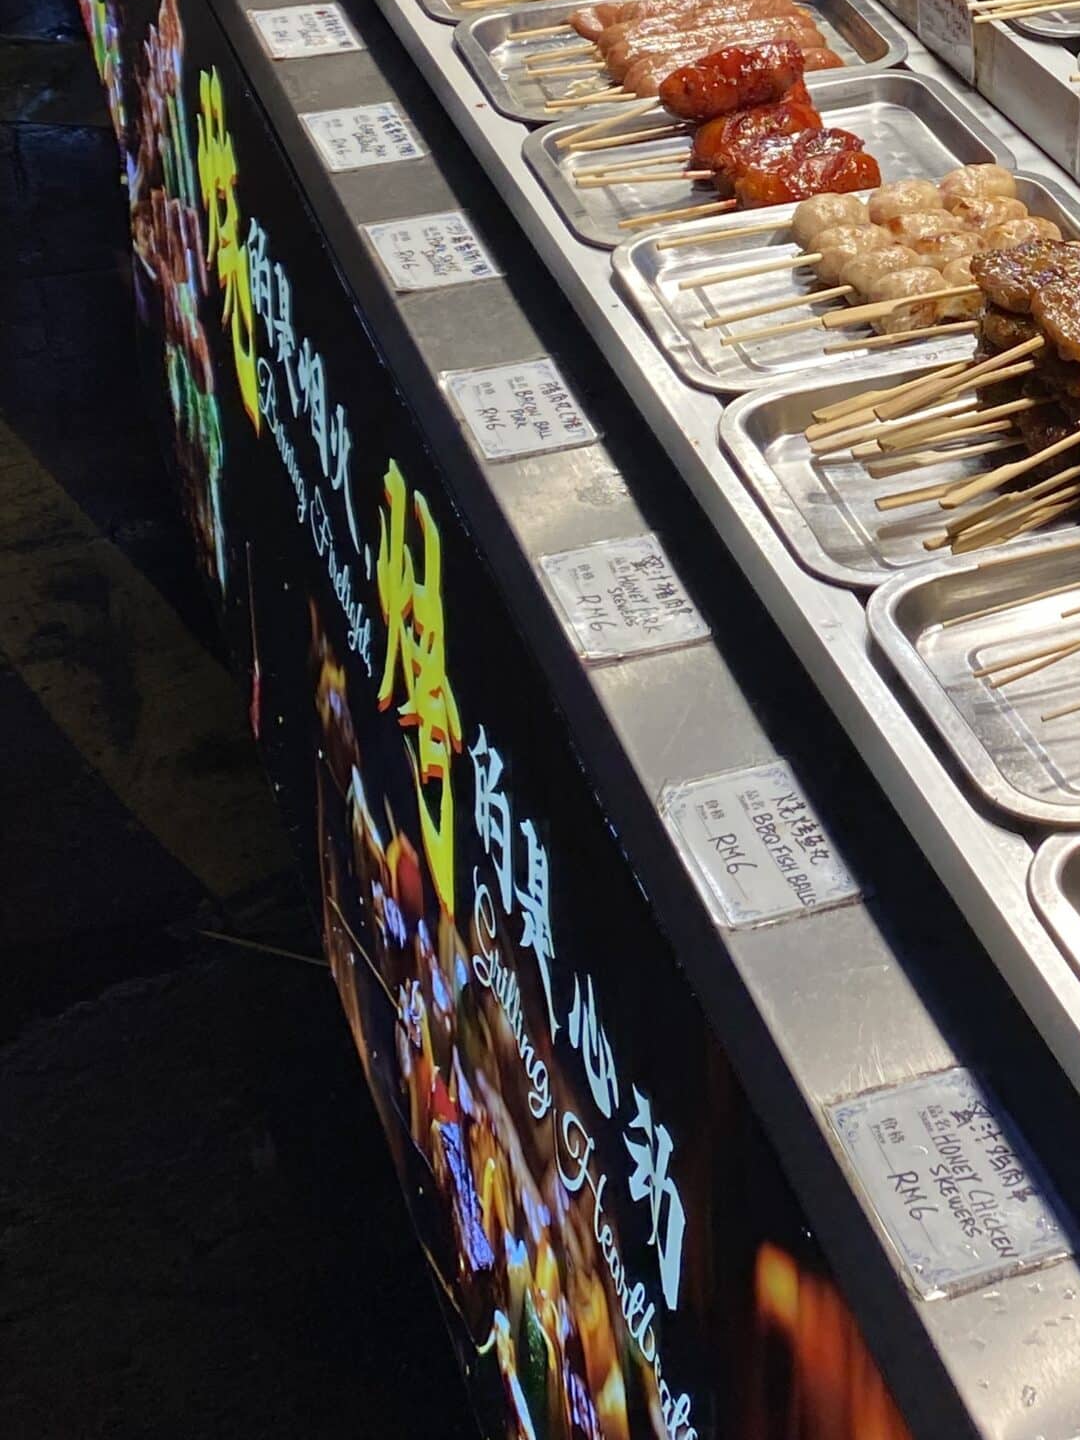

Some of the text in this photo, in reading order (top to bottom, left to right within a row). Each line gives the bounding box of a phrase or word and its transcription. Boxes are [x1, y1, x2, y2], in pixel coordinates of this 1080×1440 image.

[399, 250, 418, 269] RM6
[479, 408, 505, 430] RM6
[533, 421, 549, 439] BALL
[619, 576, 649, 602] HONEY
[578, 595, 616, 631] RM6
[256, 358, 307, 523] Burning
[471, 864, 552, 1120] Grilling
[770, 792, 830, 865] 烧烤鱼丸
[708, 834, 757, 874] RM6
[753, 813, 815, 904] BBQ FISH BALLS
[932, 1135, 981, 1181] HONEY
[888, 1171, 938, 1220] RM6
[930, 1164, 981, 1237] SKEWERS
